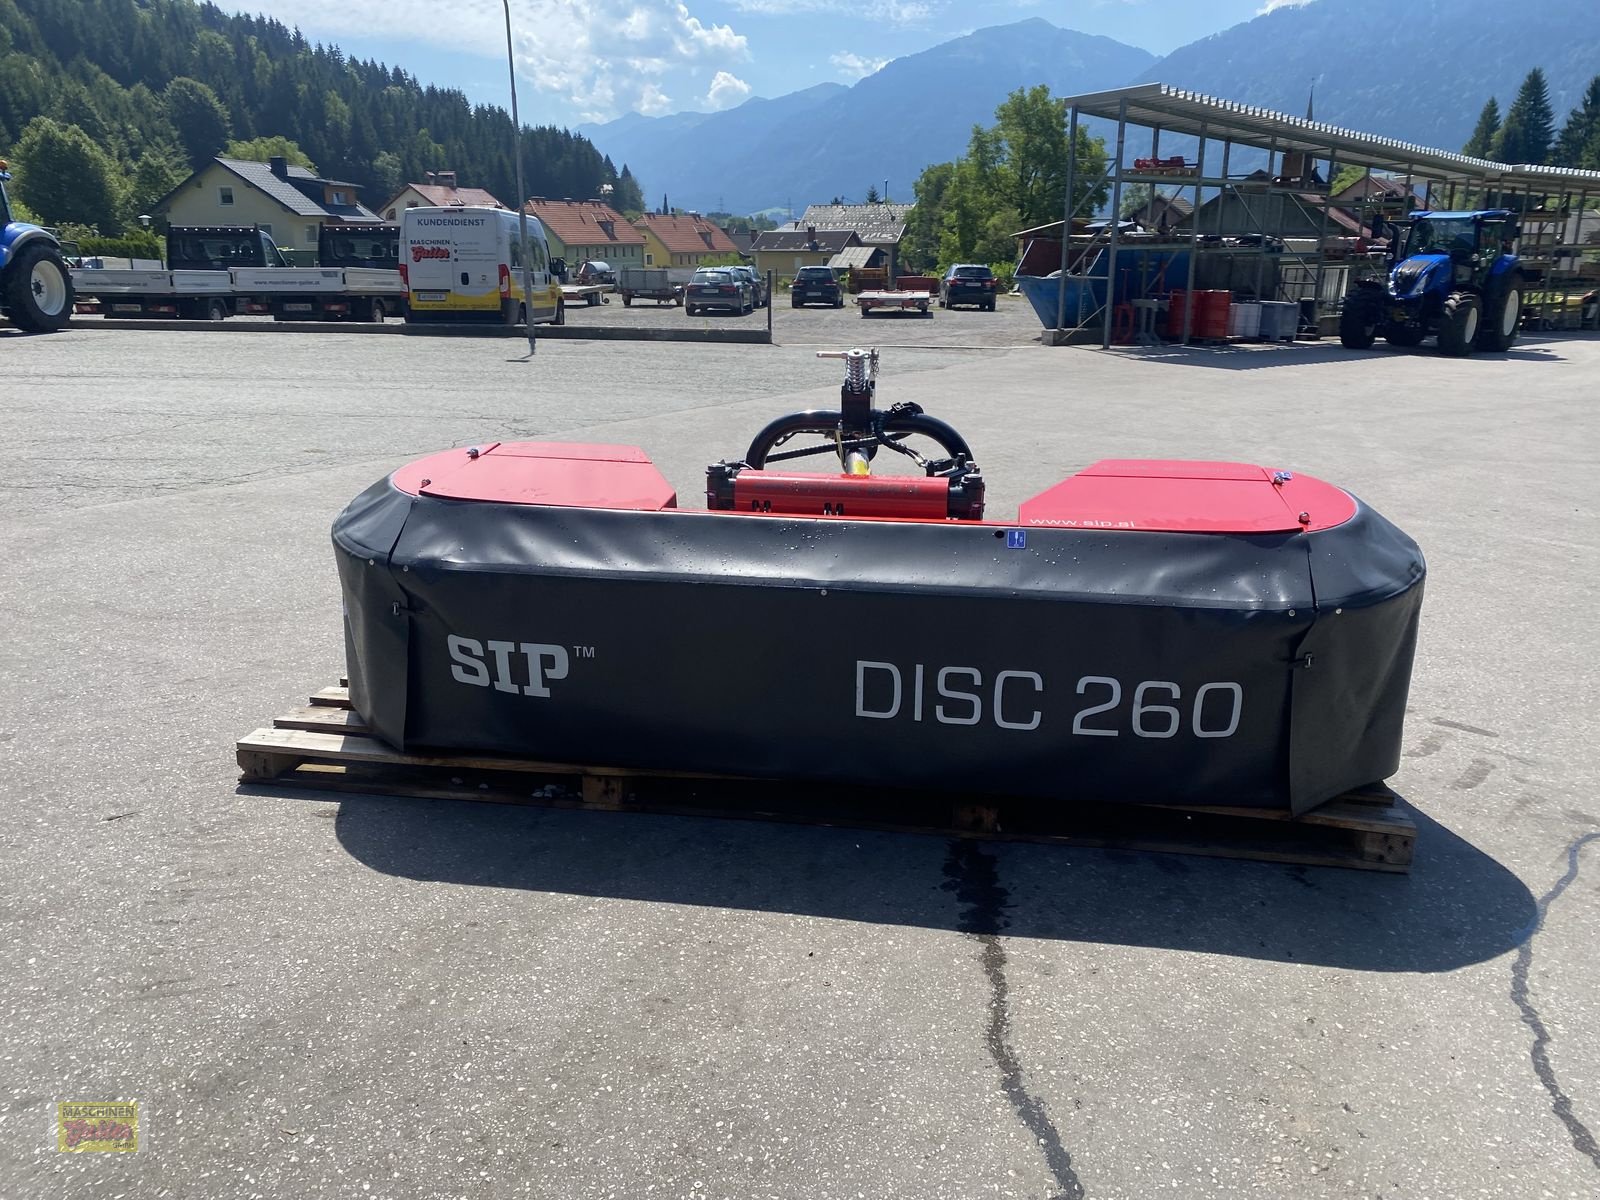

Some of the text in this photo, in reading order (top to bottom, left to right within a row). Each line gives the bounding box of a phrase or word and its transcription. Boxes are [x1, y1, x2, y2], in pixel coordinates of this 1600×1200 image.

[417, 218, 486, 227] KUNDENDIENST
[1029, 518, 1136, 528] www.sip.si
[447, 634, 569, 698] SIP
[855, 660, 1243, 738] DISC 260
